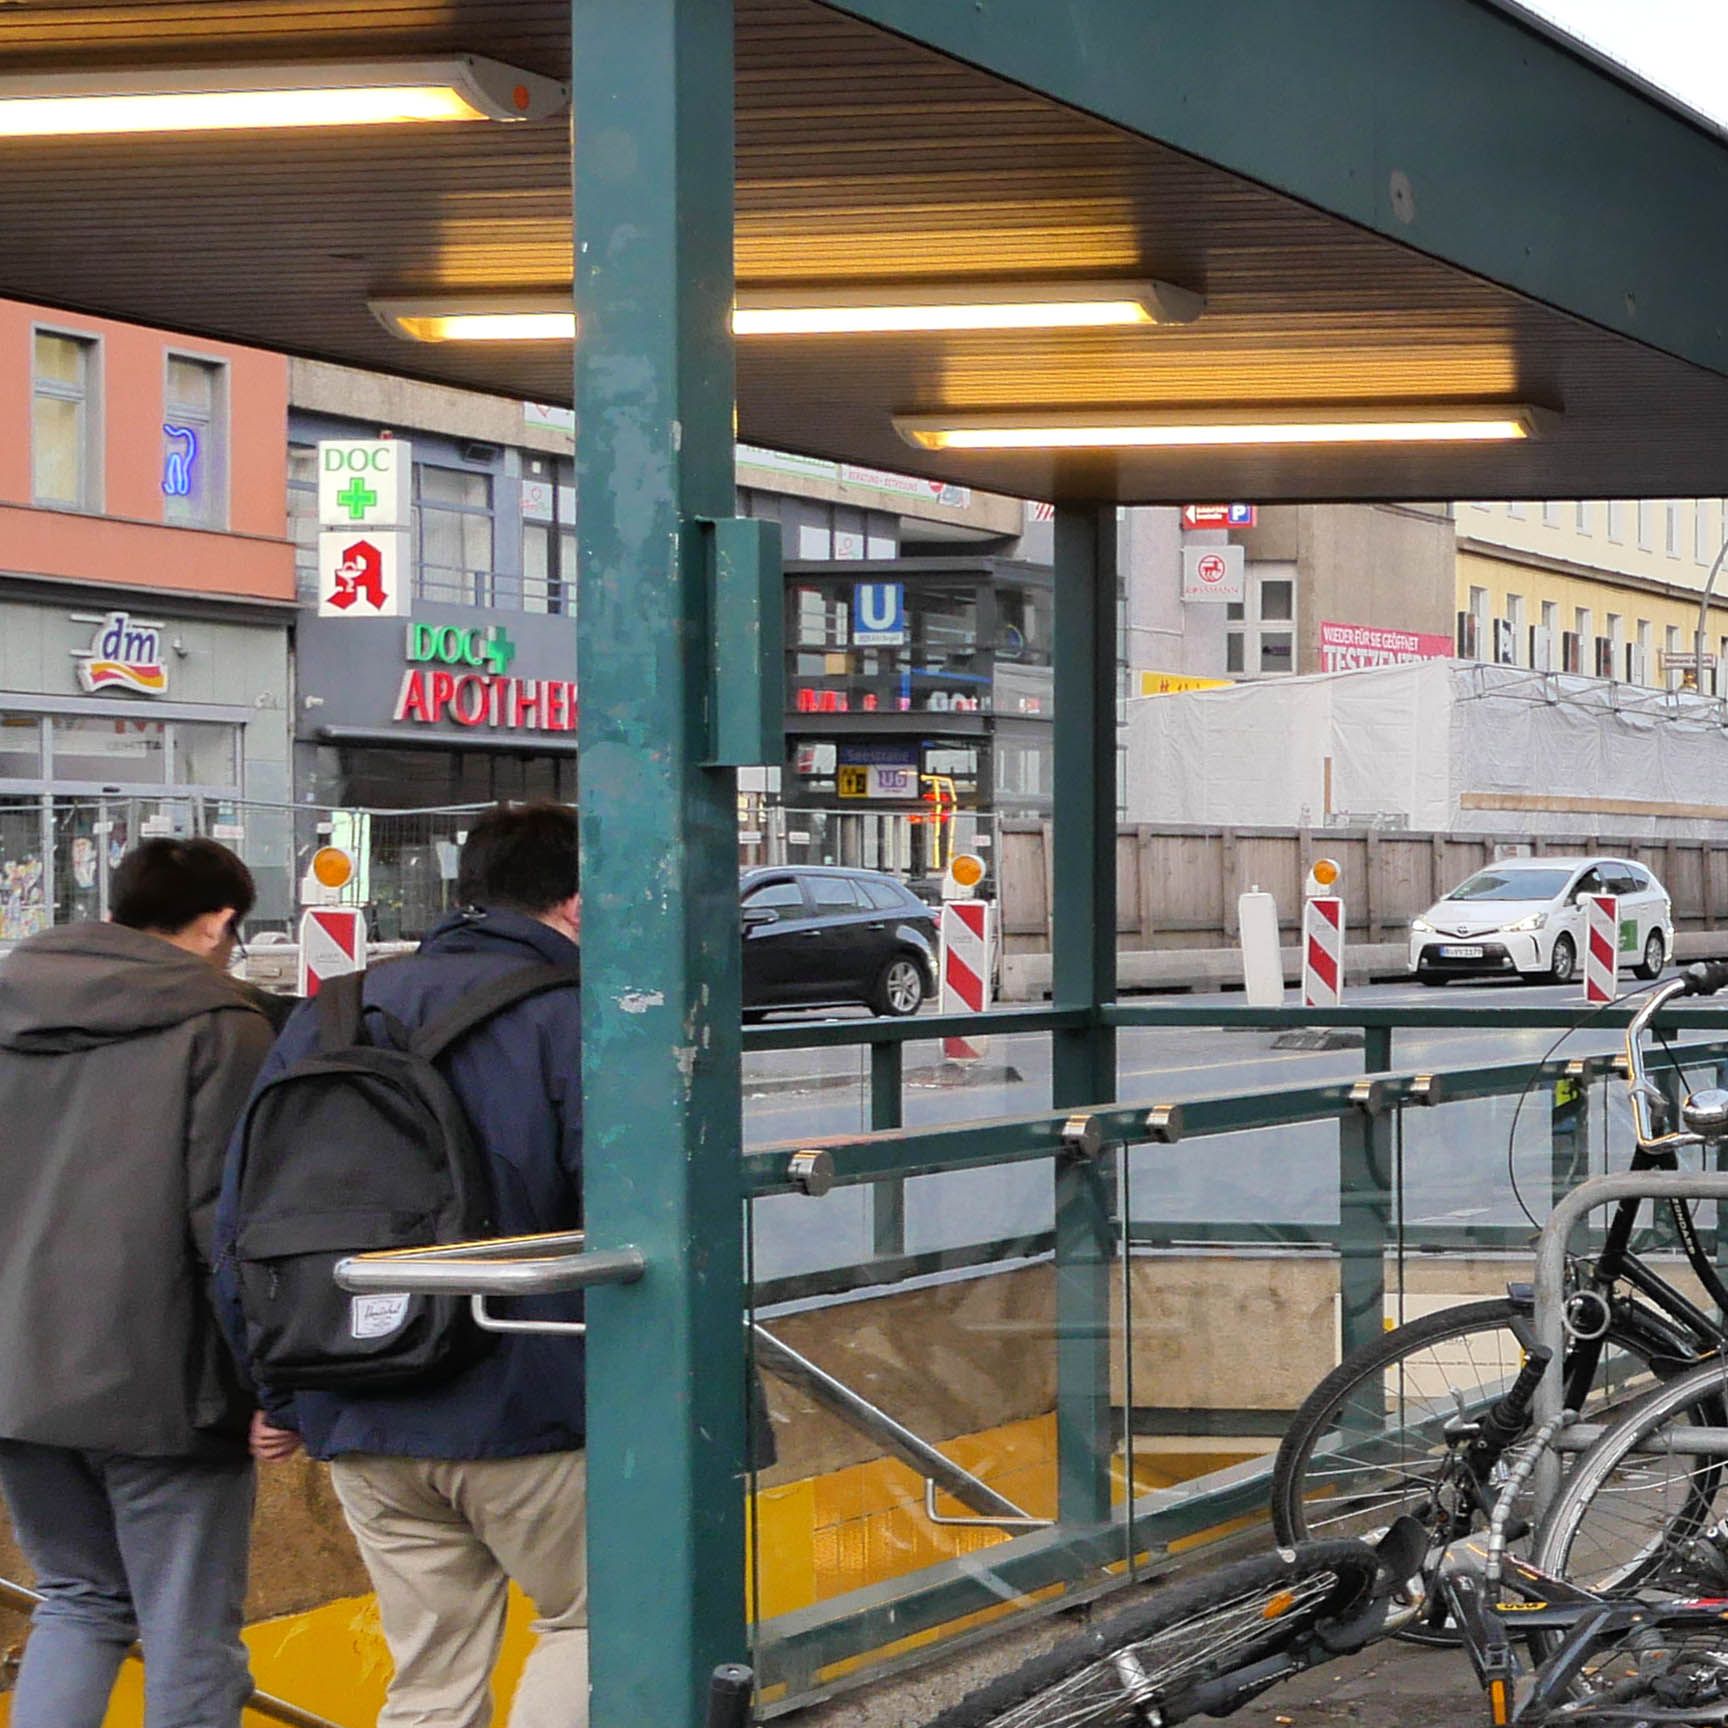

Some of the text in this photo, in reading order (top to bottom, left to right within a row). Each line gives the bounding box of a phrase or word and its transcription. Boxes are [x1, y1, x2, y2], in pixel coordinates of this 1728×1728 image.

[324, 447, 391, 473] DOC
[1231, 503, 1247, 521] P
[860, 583, 898, 631] U
[102, 617, 157, 665] dm
[407, 623, 485, 665] DOC
[1323, 626, 1419, 651] WIEDER FÜR SIE GEÖFFNET
[394, 668, 577, 731] APOTHE
